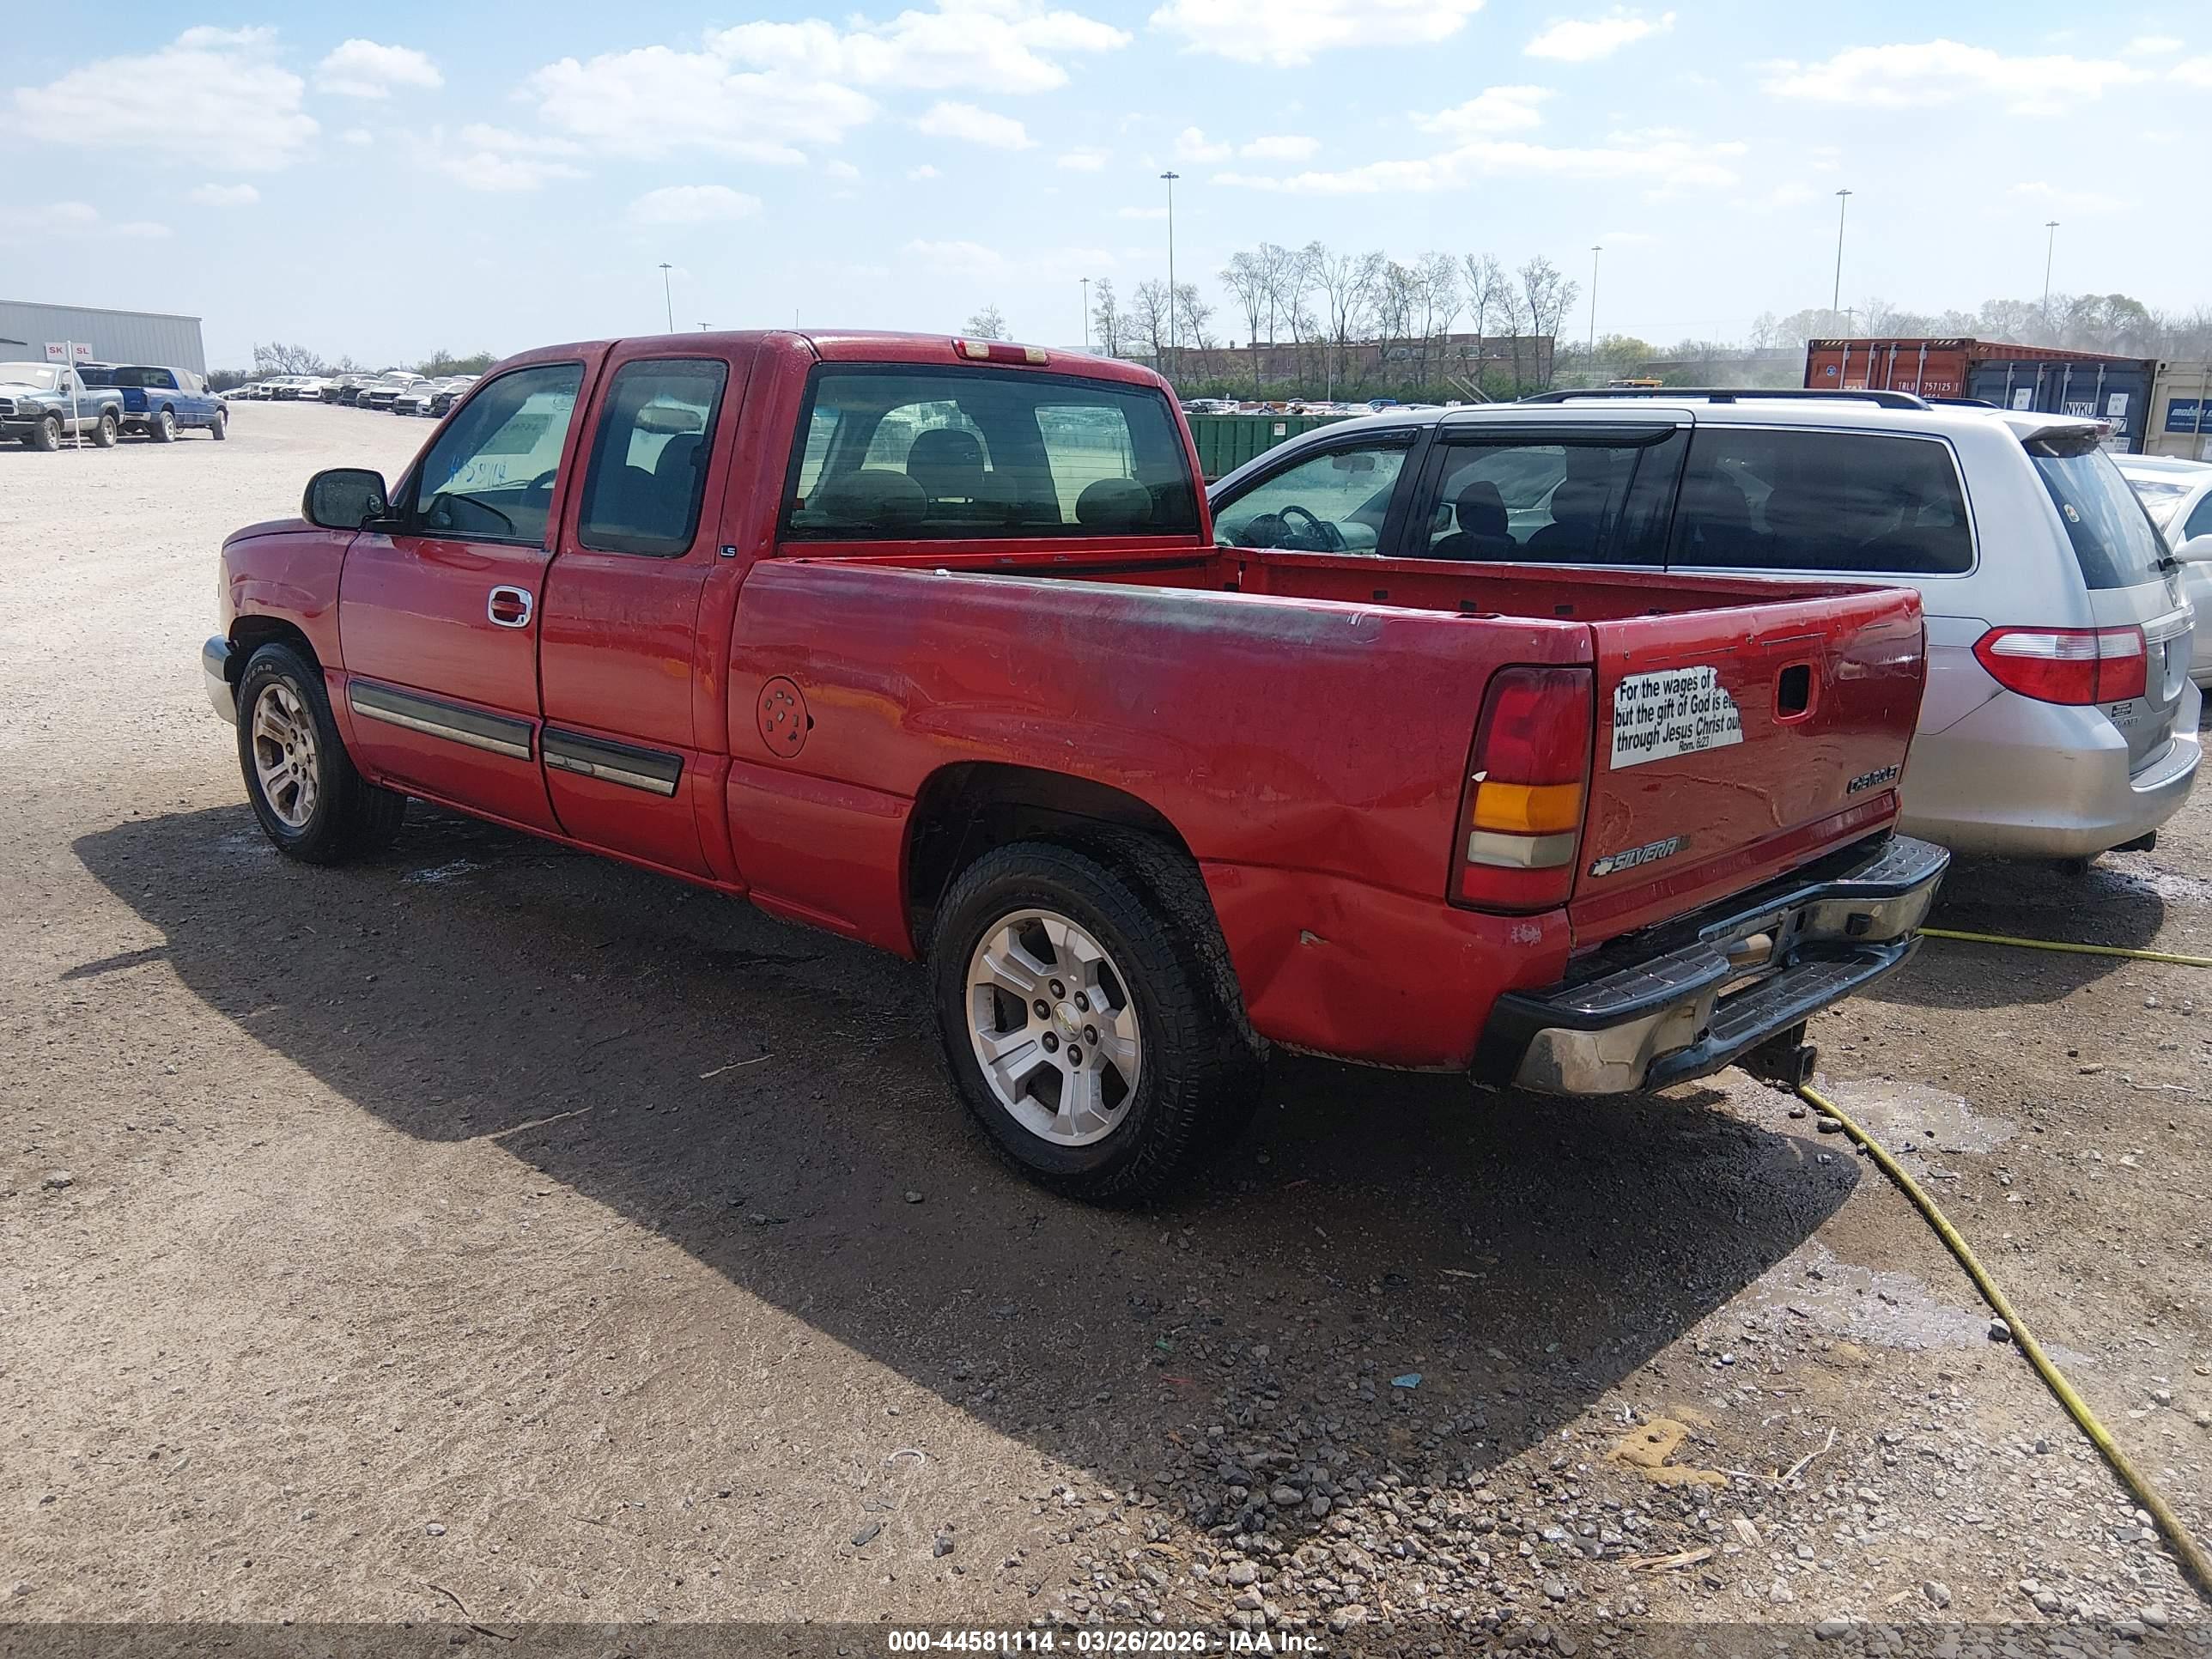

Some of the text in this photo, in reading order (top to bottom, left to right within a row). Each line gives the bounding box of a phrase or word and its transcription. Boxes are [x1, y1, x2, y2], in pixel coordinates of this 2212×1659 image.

[1923, 382, 1951, 392] 757125
[2065, 403, 2095, 416] NYKU
[2171, 405, 2207, 417] mobie
[720, 546, 736, 556] LS
[1620, 669, 1711, 702] For the wages of
[1615, 706, 1633, 728] but
[1637, 702, 1655, 724] the
[1656, 698, 1674, 726] gift
[1677, 695, 1688, 717] of
[1690, 692, 1711, 714] God
[1712, 692, 1721, 711] is
[1617, 725, 1660, 752] through
[1662, 722, 1692, 744] Jesus
[1696, 714, 1724, 737] Christ
[1678, 735, 1710, 752] Rom. 6:23
[1611, 835, 1683, 872] SILVERA
